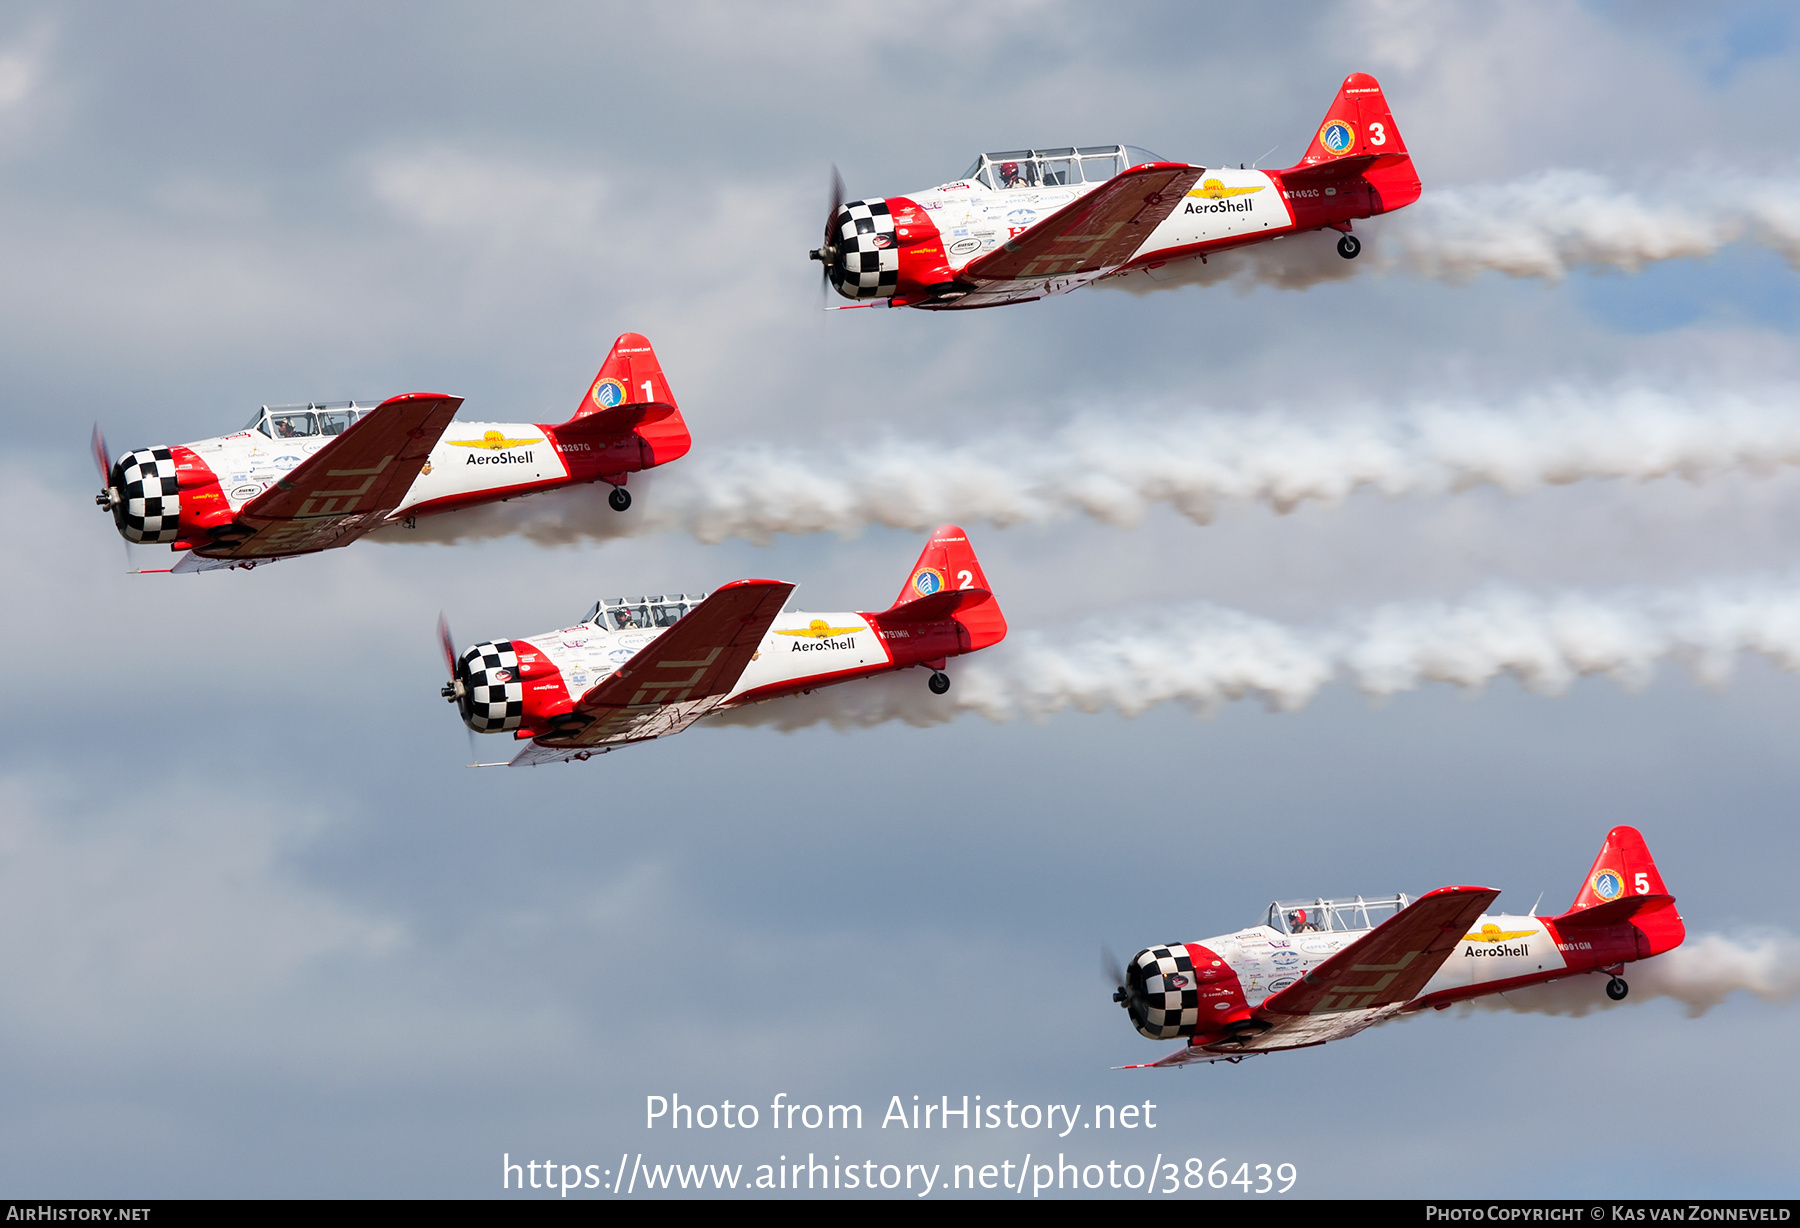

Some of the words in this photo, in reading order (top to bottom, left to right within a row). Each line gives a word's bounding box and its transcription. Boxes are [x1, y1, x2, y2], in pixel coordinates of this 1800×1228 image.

[1369, 122, 1386, 146] 3
[1282, 189, 1319, 199] N7462C
[1184, 199, 1253, 214] AeroShell
[640, 380, 654, 402] 1
[466, 451, 534, 465] AeroShell
[957, 569, 974, 590] 2
[791, 637, 856, 652] AeroShell
[1634, 872, 1650, 895] 5
[1465, 944, 1529, 957] AeroShell
